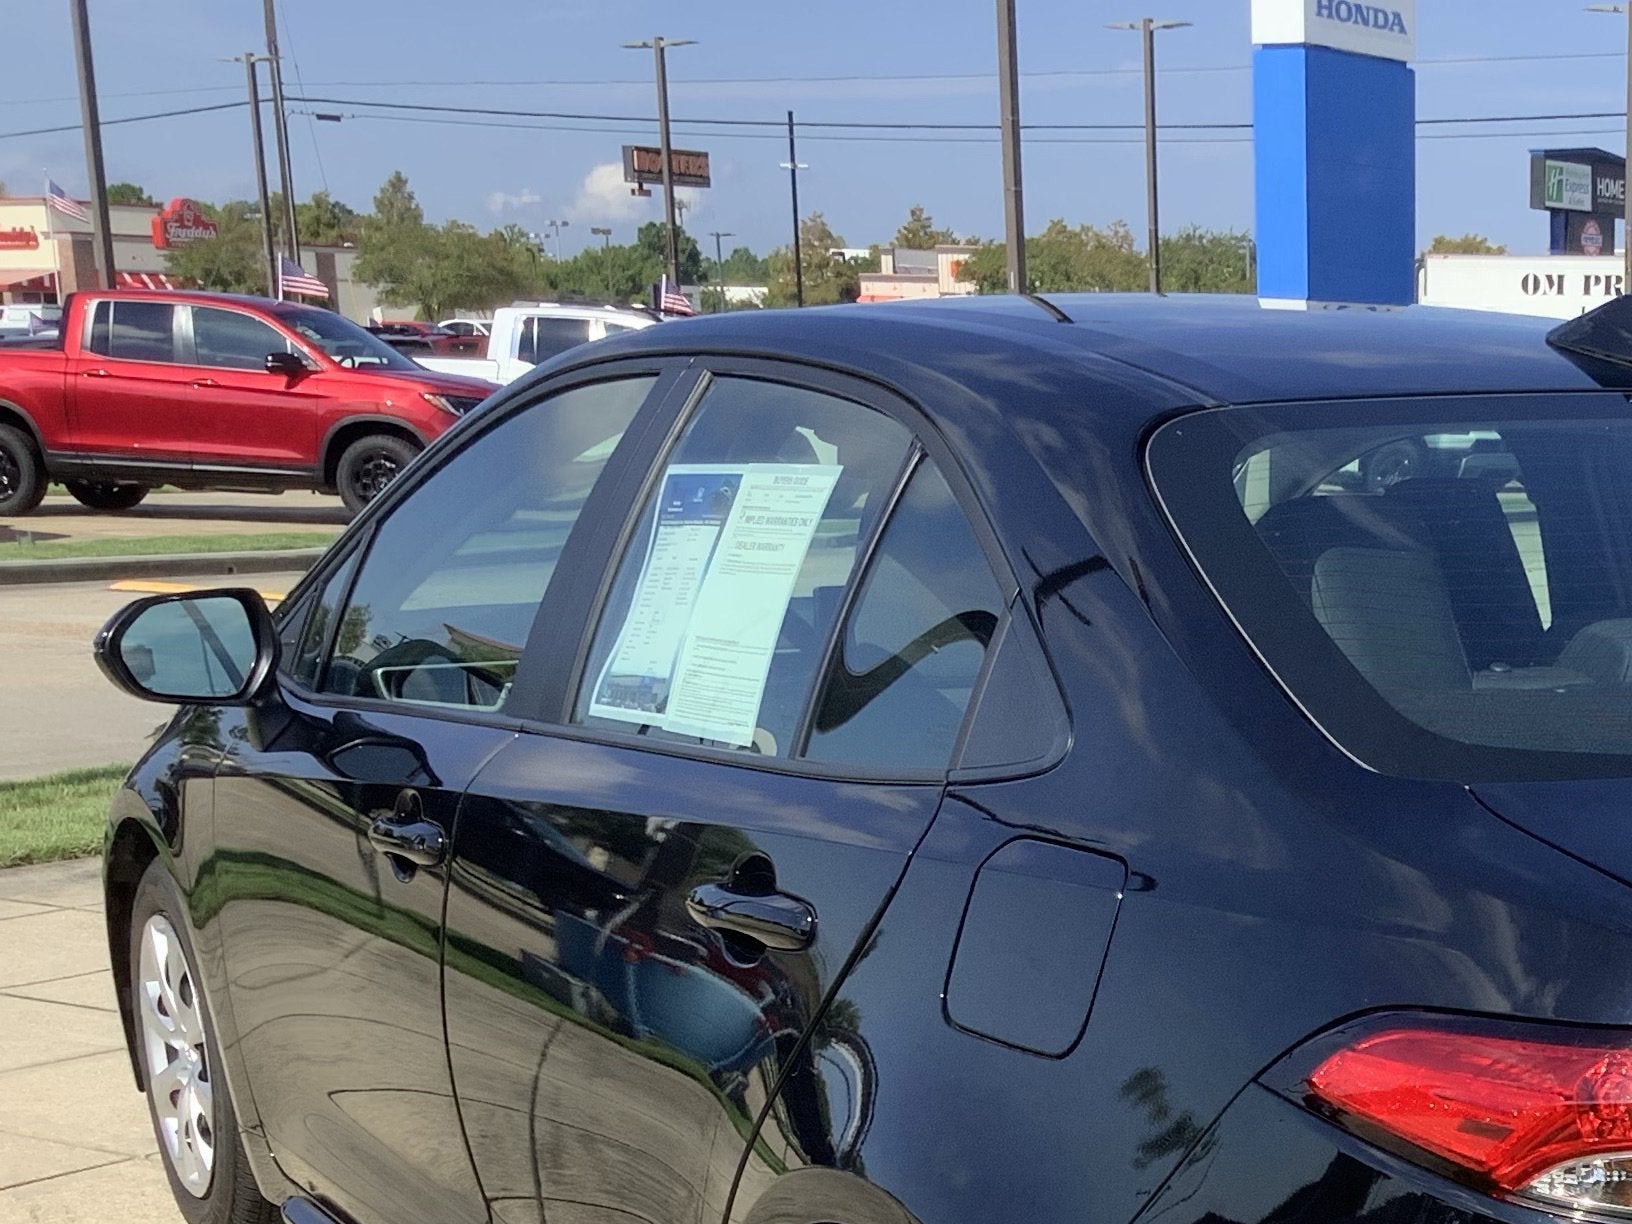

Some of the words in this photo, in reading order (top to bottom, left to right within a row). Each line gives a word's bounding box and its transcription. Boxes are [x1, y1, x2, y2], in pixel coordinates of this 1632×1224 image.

[1315, 0, 1407, 35] HONDA
[1596, 177, 1625, 199] HOME
[1521, 272, 1565, 296] OM
